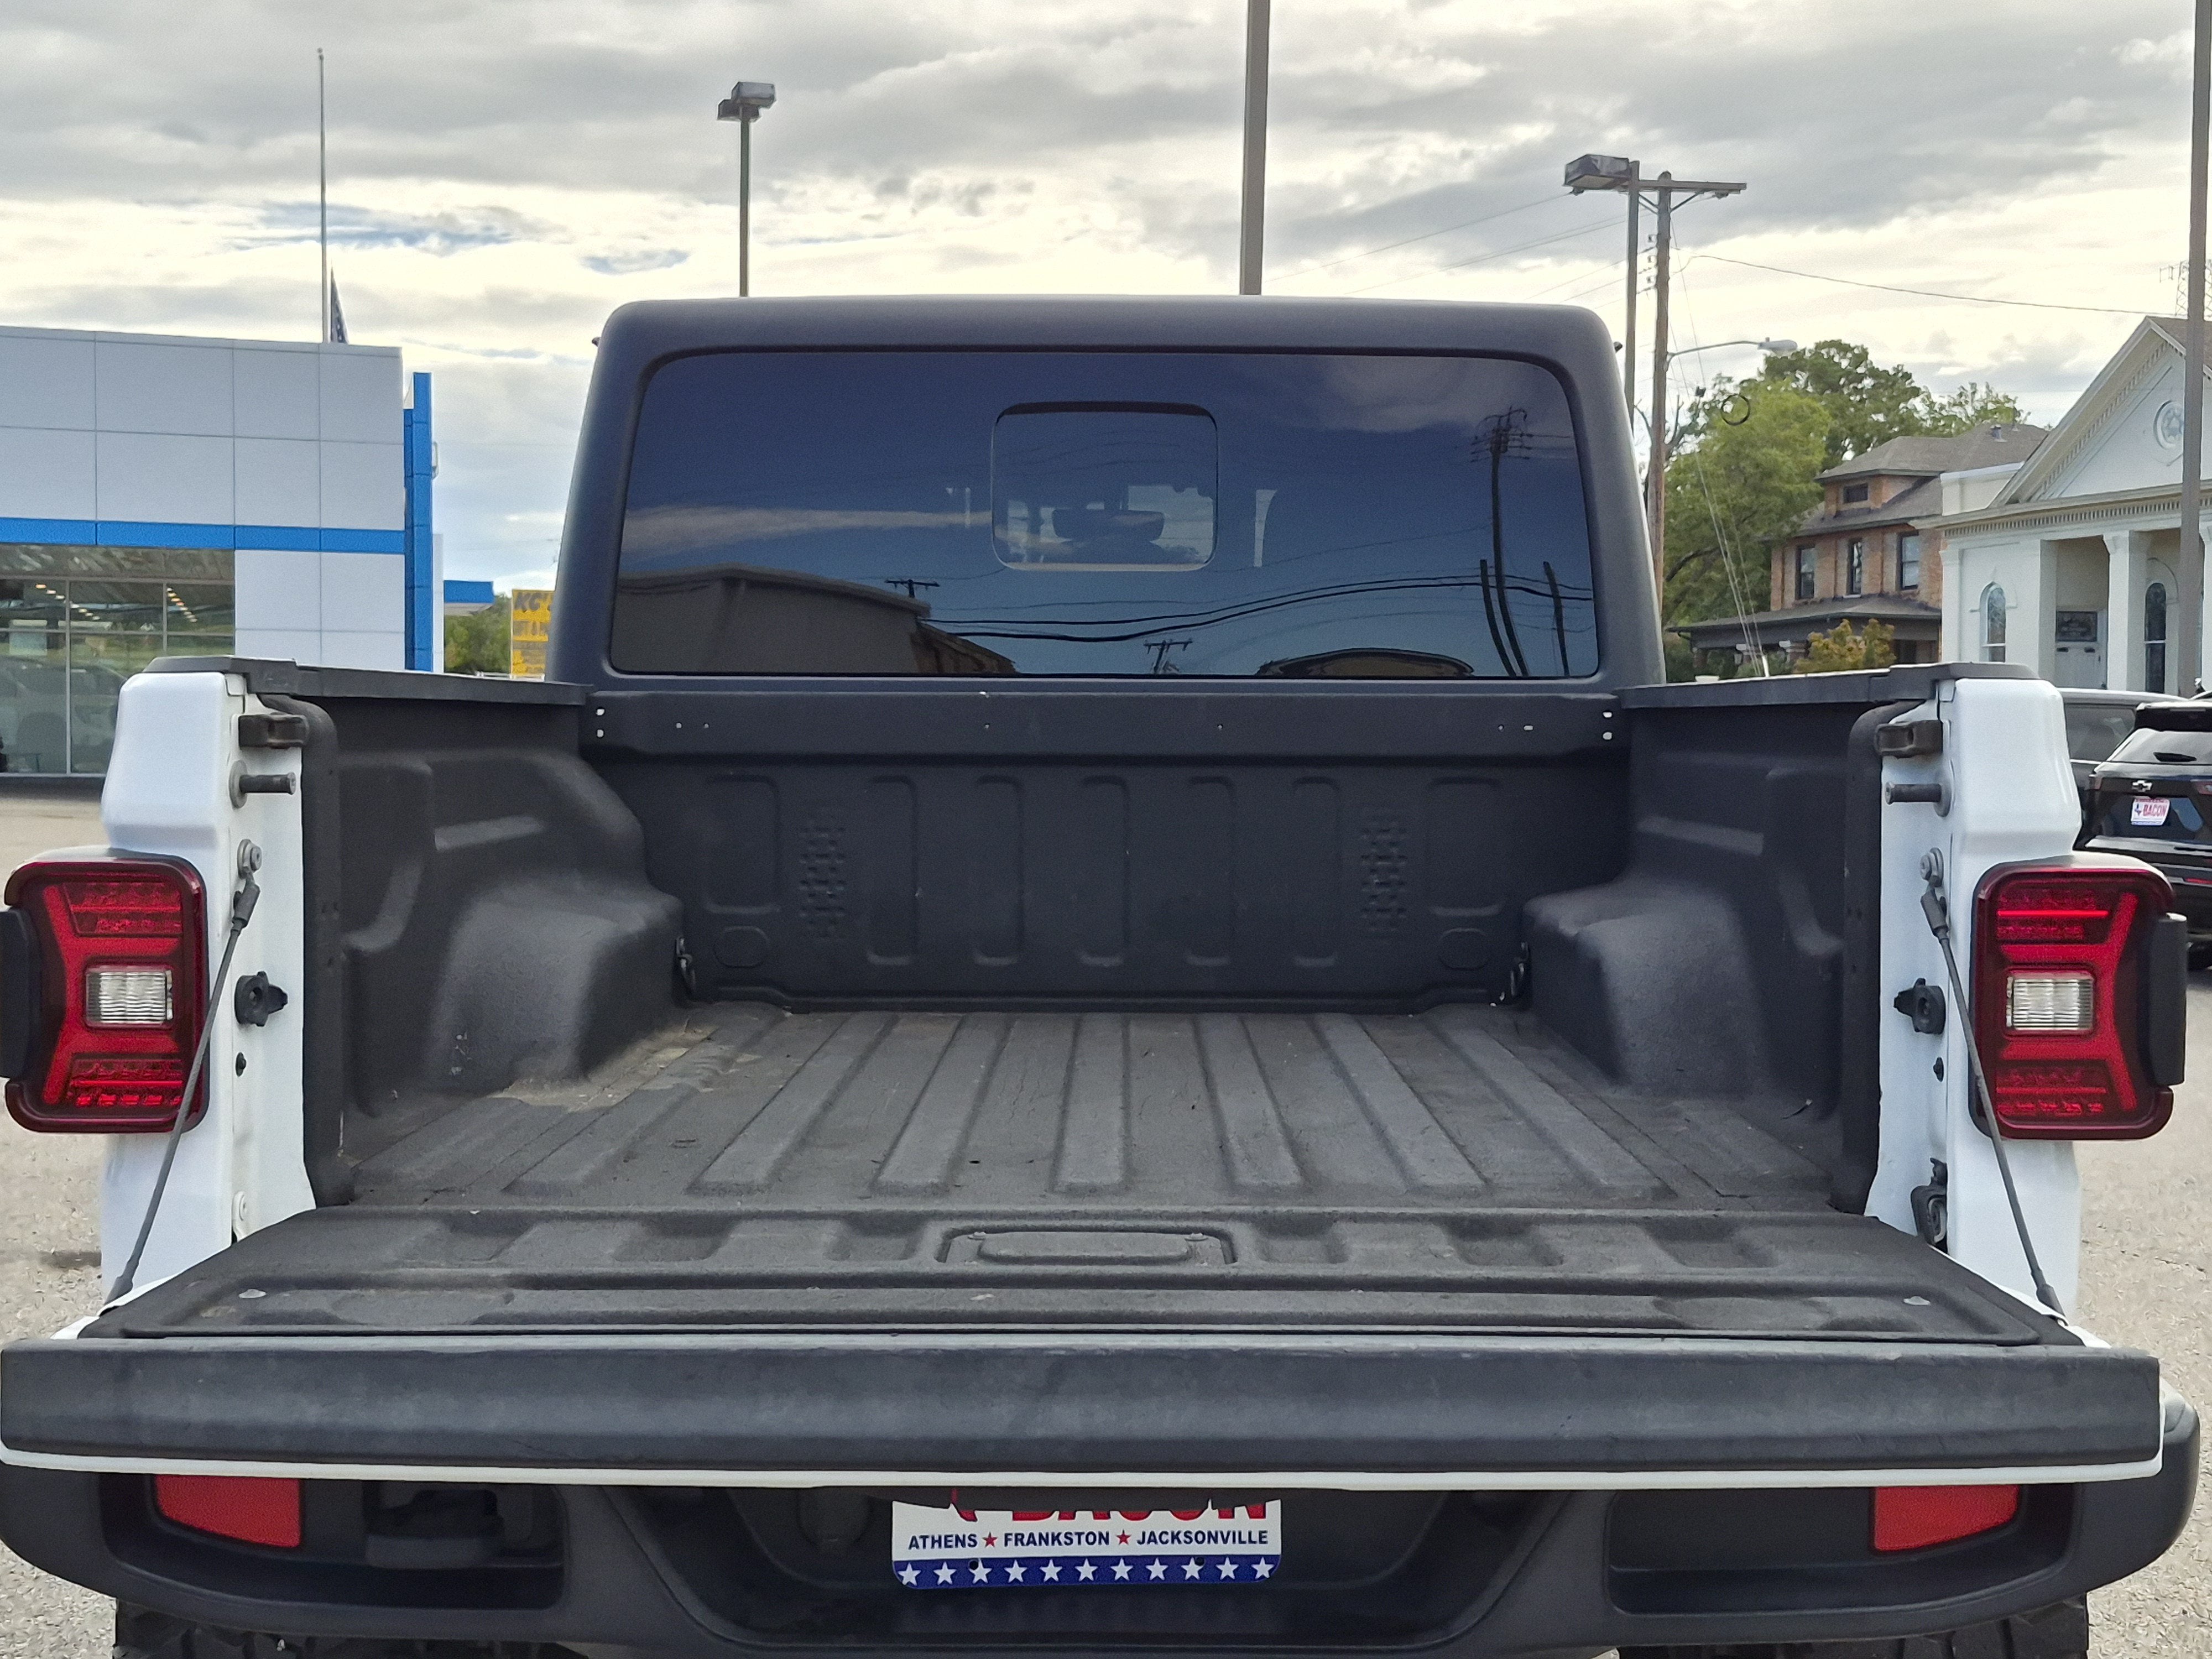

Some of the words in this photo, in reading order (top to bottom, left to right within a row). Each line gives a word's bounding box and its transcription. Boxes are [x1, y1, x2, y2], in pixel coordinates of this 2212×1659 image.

[2143, 804, 2167, 817] BACON
[908, 1534, 978, 1550] ATHENS
[1004, 1531, 1110, 1547] FRANKSTON
[1136, 1530, 1269, 1546] JACKSONVILLE
